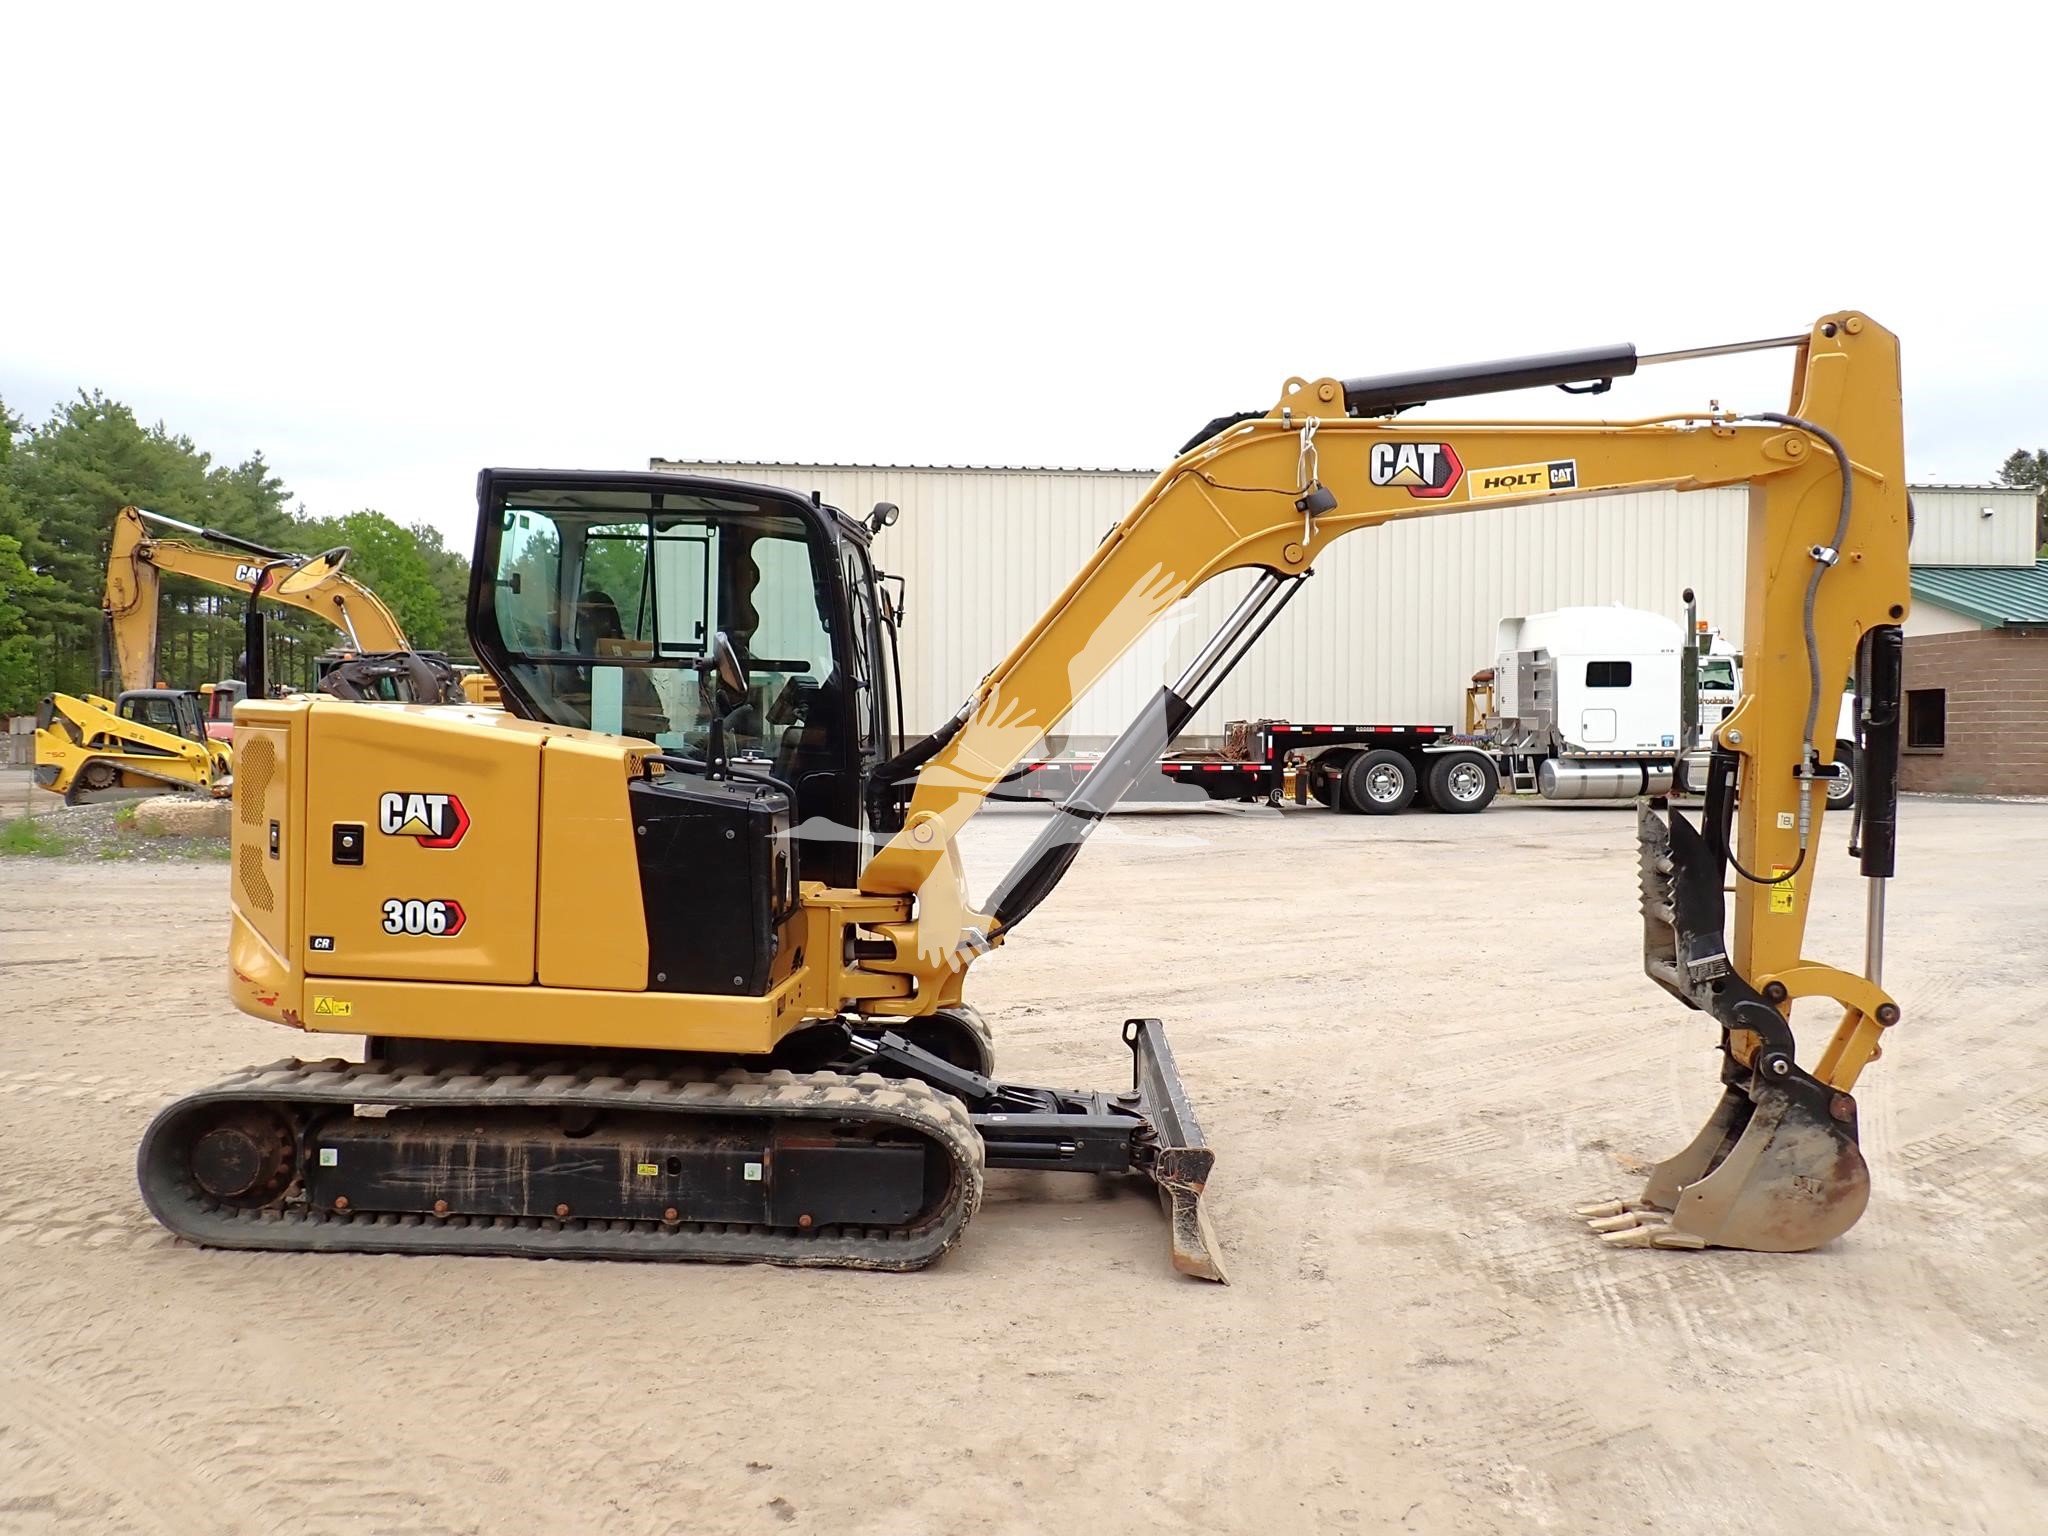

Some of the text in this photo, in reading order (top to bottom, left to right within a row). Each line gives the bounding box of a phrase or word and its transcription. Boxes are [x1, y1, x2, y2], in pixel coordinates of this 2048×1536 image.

[1371, 444, 1440, 485] CAT
[1484, 467, 1572, 489] HOLT CAT
[380, 793, 448, 836] CAT
[383, 900, 446, 934] 306
[314, 937, 330, 949] CR
